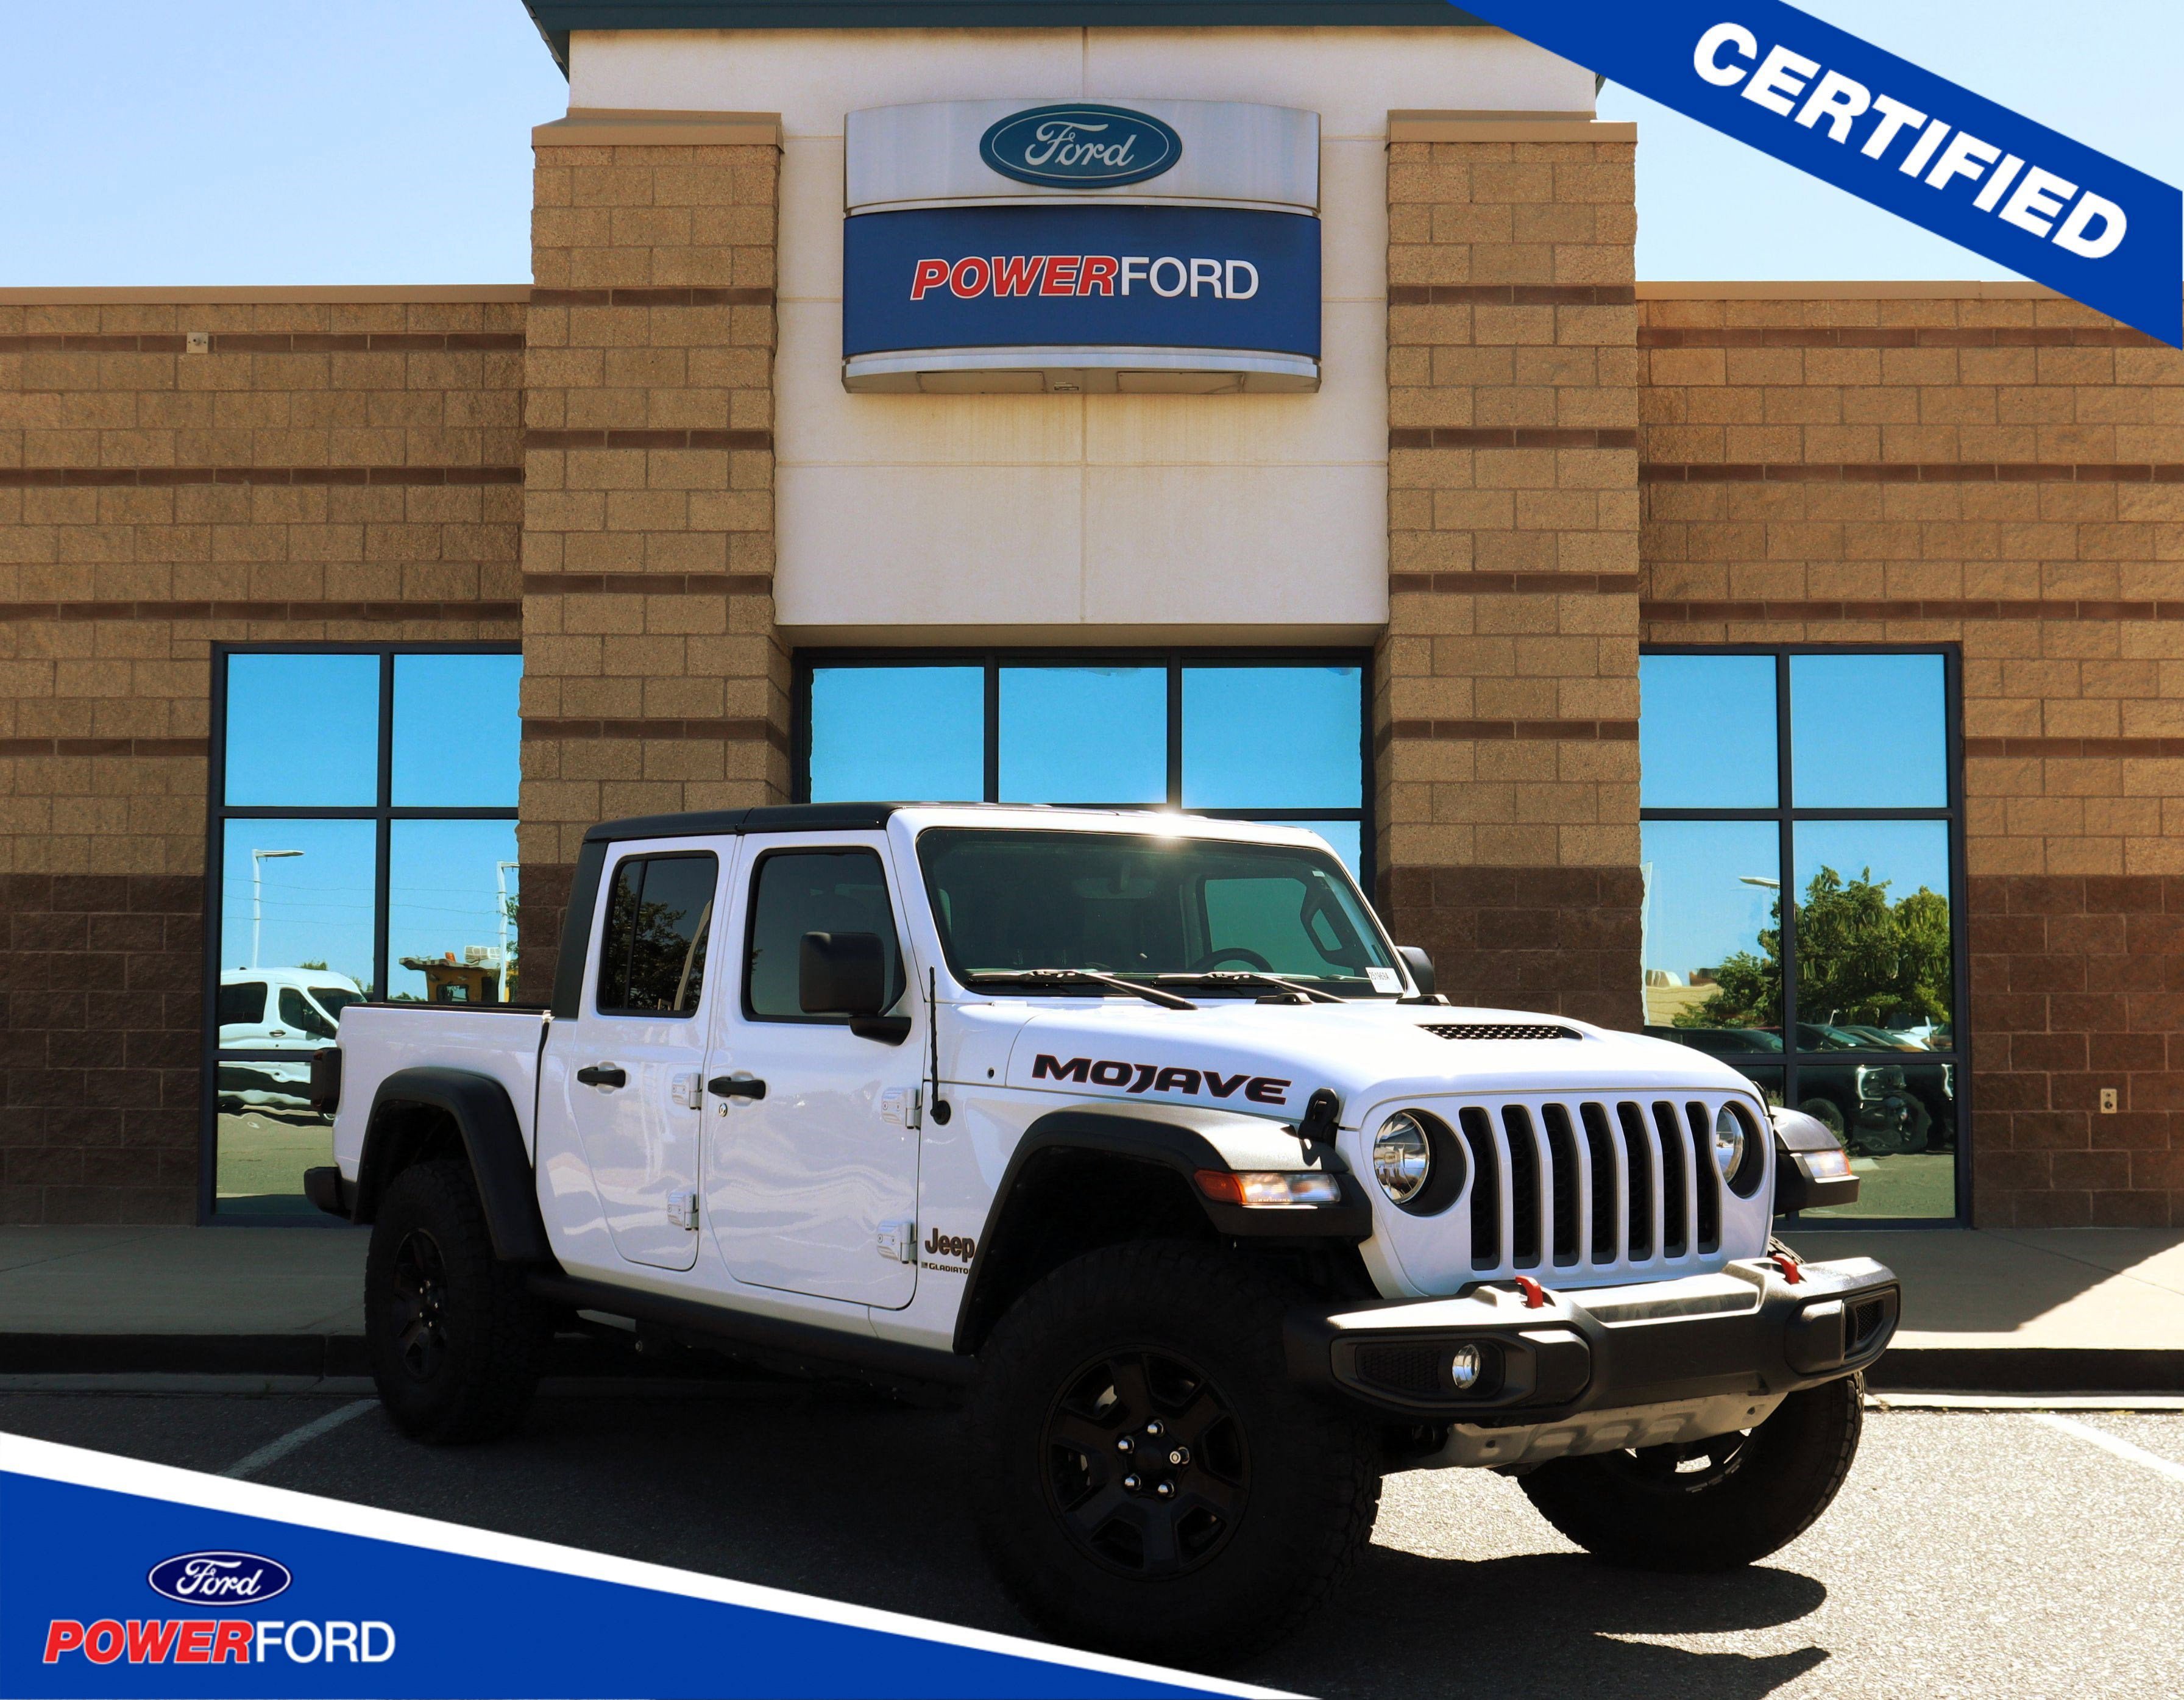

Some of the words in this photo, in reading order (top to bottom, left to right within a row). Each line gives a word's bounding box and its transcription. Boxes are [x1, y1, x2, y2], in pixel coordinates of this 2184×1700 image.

[1025, 121, 1137, 167] Ford
[1032, 1054, 1291, 1105] MOJAVE
[924, 1228, 975, 1263] Jeep
[929, 1262, 971, 1275] GLADIATO
